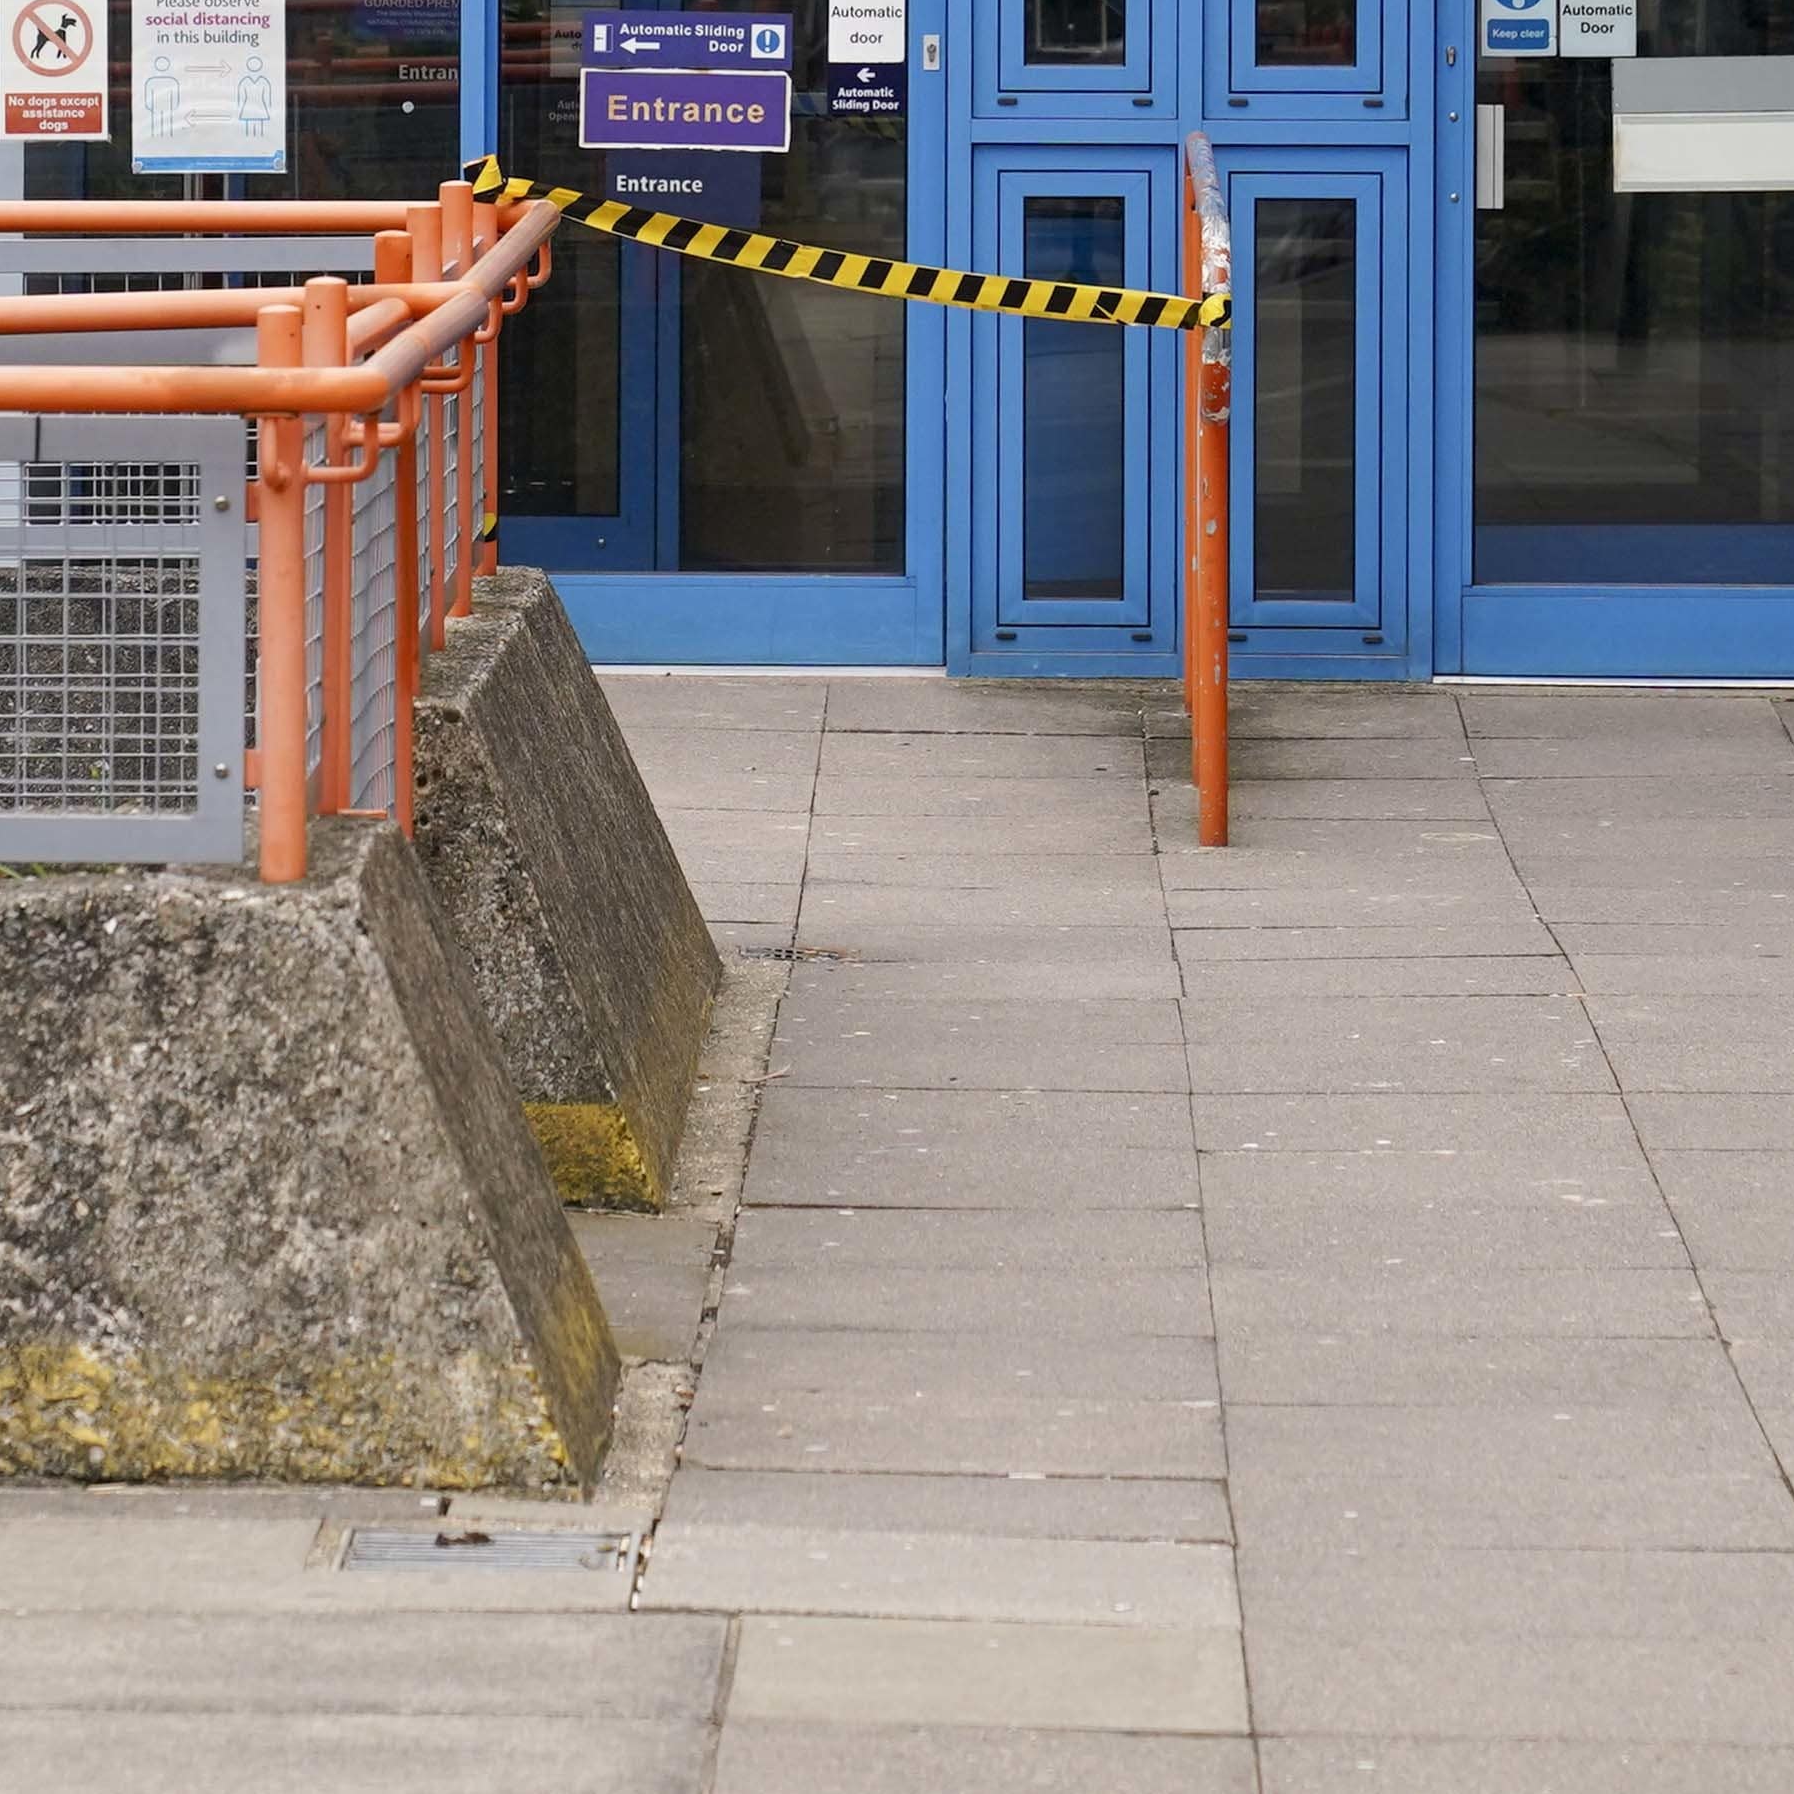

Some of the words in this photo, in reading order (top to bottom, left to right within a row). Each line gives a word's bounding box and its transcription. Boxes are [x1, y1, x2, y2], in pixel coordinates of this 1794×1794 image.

[830, 5, 903, 18] Automatic
[1562, 4, 1633, 16] Automatic
[145, 12, 189, 26] social
[192, 12, 271, 29] distancing
[619, 23, 692, 37] Automatic
[694, 24, 745, 40] Sliding
[1492, 28, 1519, 40] Keep
[1520, 28, 1544, 39] clear
[1580, 21, 1615, 34] Door
[156, 30, 170, 43] in
[174, 30, 200, 44] this
[203, 29, 260, 47] building
[849, 31, 884, 44] door
[708, 40, 744, 53] Door
[398, 64, 458, 80] Entran
[837, 86, 895, 98] Automatic
[8, 95, 25, 106] No
[27, 95, 57, 109] dogs
[59, 95, 100, 108] except
[832, 99, 871, 112] Sliding
[872, 99, 900, 111] Door
[21, 108, 86, 118] assistance
[606, 94, 766, 124] Entrance
[38, 119, 69, 132] dogs
[615, 174, 704, 193] Entrance
